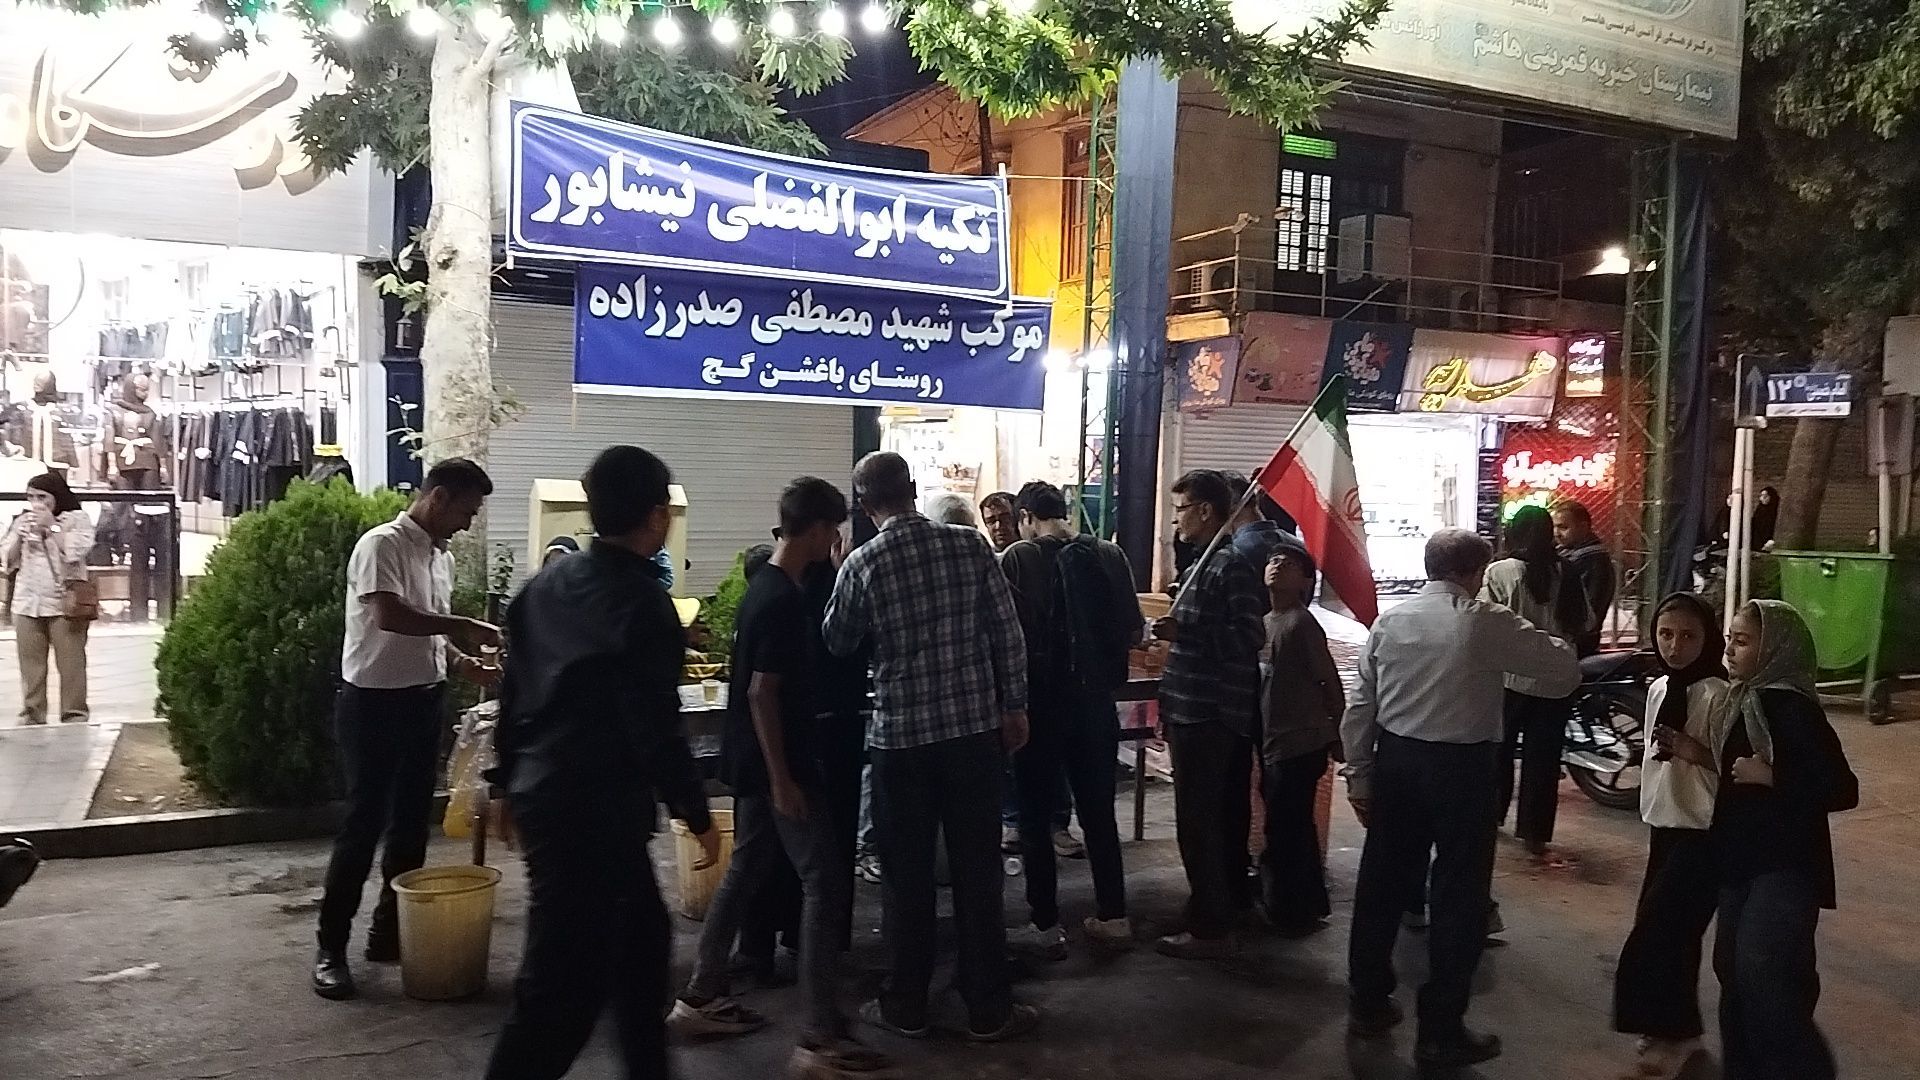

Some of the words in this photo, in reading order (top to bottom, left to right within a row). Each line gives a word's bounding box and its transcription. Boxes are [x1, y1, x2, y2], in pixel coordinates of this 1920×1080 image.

[1637, 64, 1713, 106] بیمارستان
[530, 150, 696, 233] نیشابور
[706, 171, 907, 258] ابوالفضلی
[916, 203, 993, 265] تکیه
[749, 287, 873, 344] مصطفی
[880, 301, 953, 353] شهید
[959, 298, 1045, 362] موکب
[701, 353, 755, 384] گچ
[759, 353, 845, 393] باغشن
[848, 360, 944, 399] روستای
